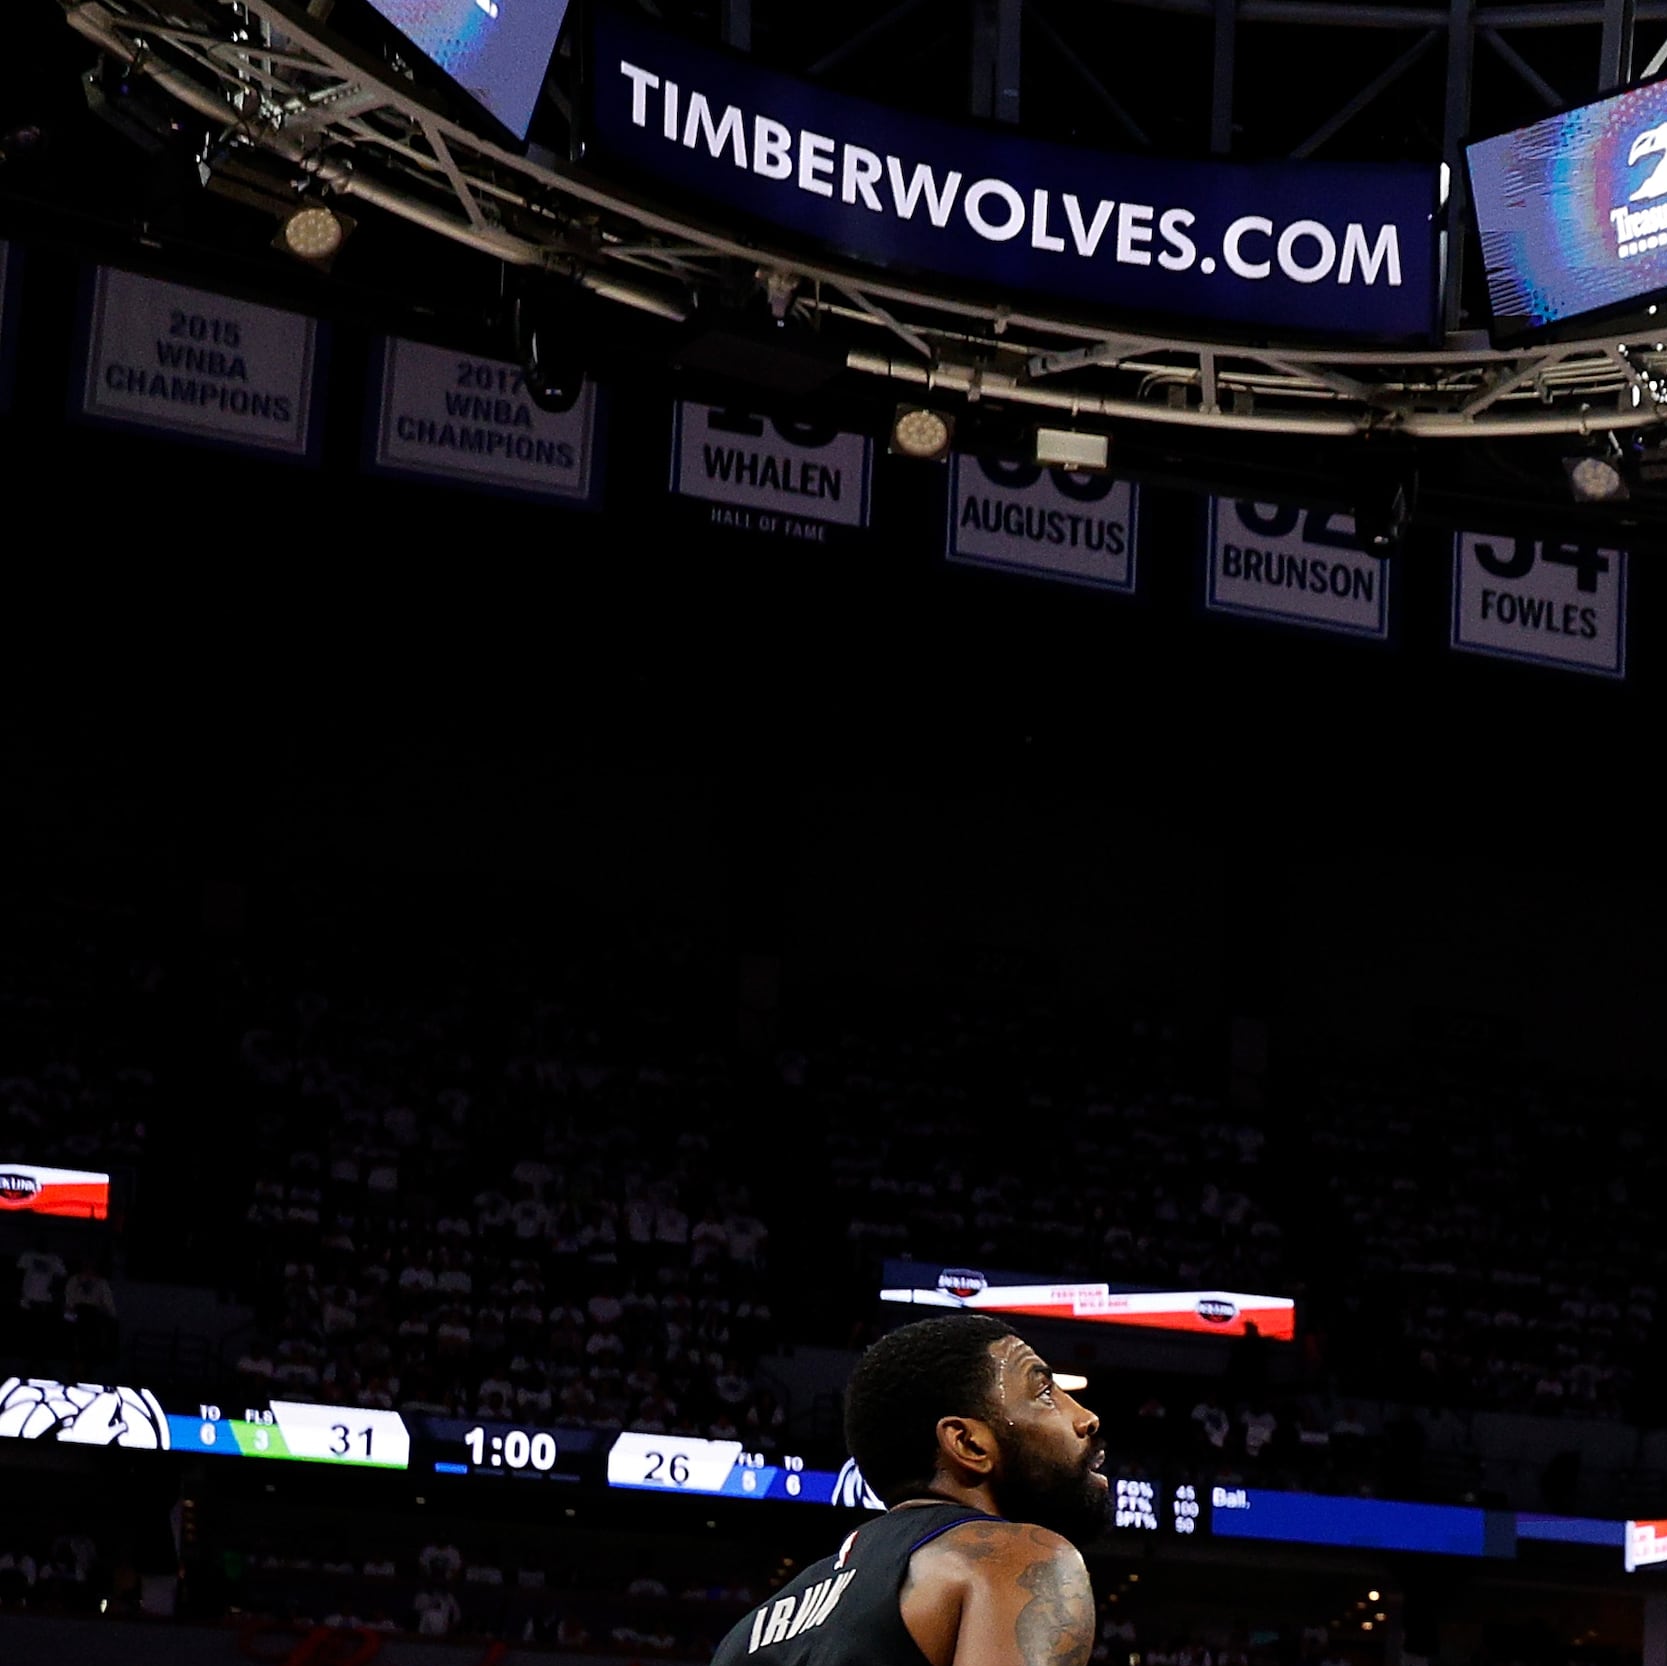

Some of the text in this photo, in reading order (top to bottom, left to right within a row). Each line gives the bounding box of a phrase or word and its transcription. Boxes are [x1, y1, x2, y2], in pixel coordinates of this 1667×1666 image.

[620, 60, 1402, 286] TIMBERWOLVES.COM
[171, 312, 241, 348] 2015
[157, 341, 248, 381] WNBA
[457, 361, 522, 394] 2017
[106, 364, 291, 423] CHAMPIONS
[445, 390, 532, 427] WNBA
[397, 415, 575, 469] CHAMPIONS
[703, 445, 841, 502] WHALEN
[711, 506, 825, 541] HALL OF FAME
[960, 496, 1125, 556] AUGUSTUS
[1222, 545, 1374, 602] BRUNSON
[1480, 589, 1597, 641] FOWLES
[200, 1404, 273, 1426] TO FLS
[329, 1424, 374, 1458] 31
[465, 1427, 556, 1472] 1:00
[643, 1451, 690, 1486] 26
[785, 1456, 803, 1471] TO
[1117, 1480, 1153, 1498] FG%
[1212, 1486, 1250, 1510] Ball,
